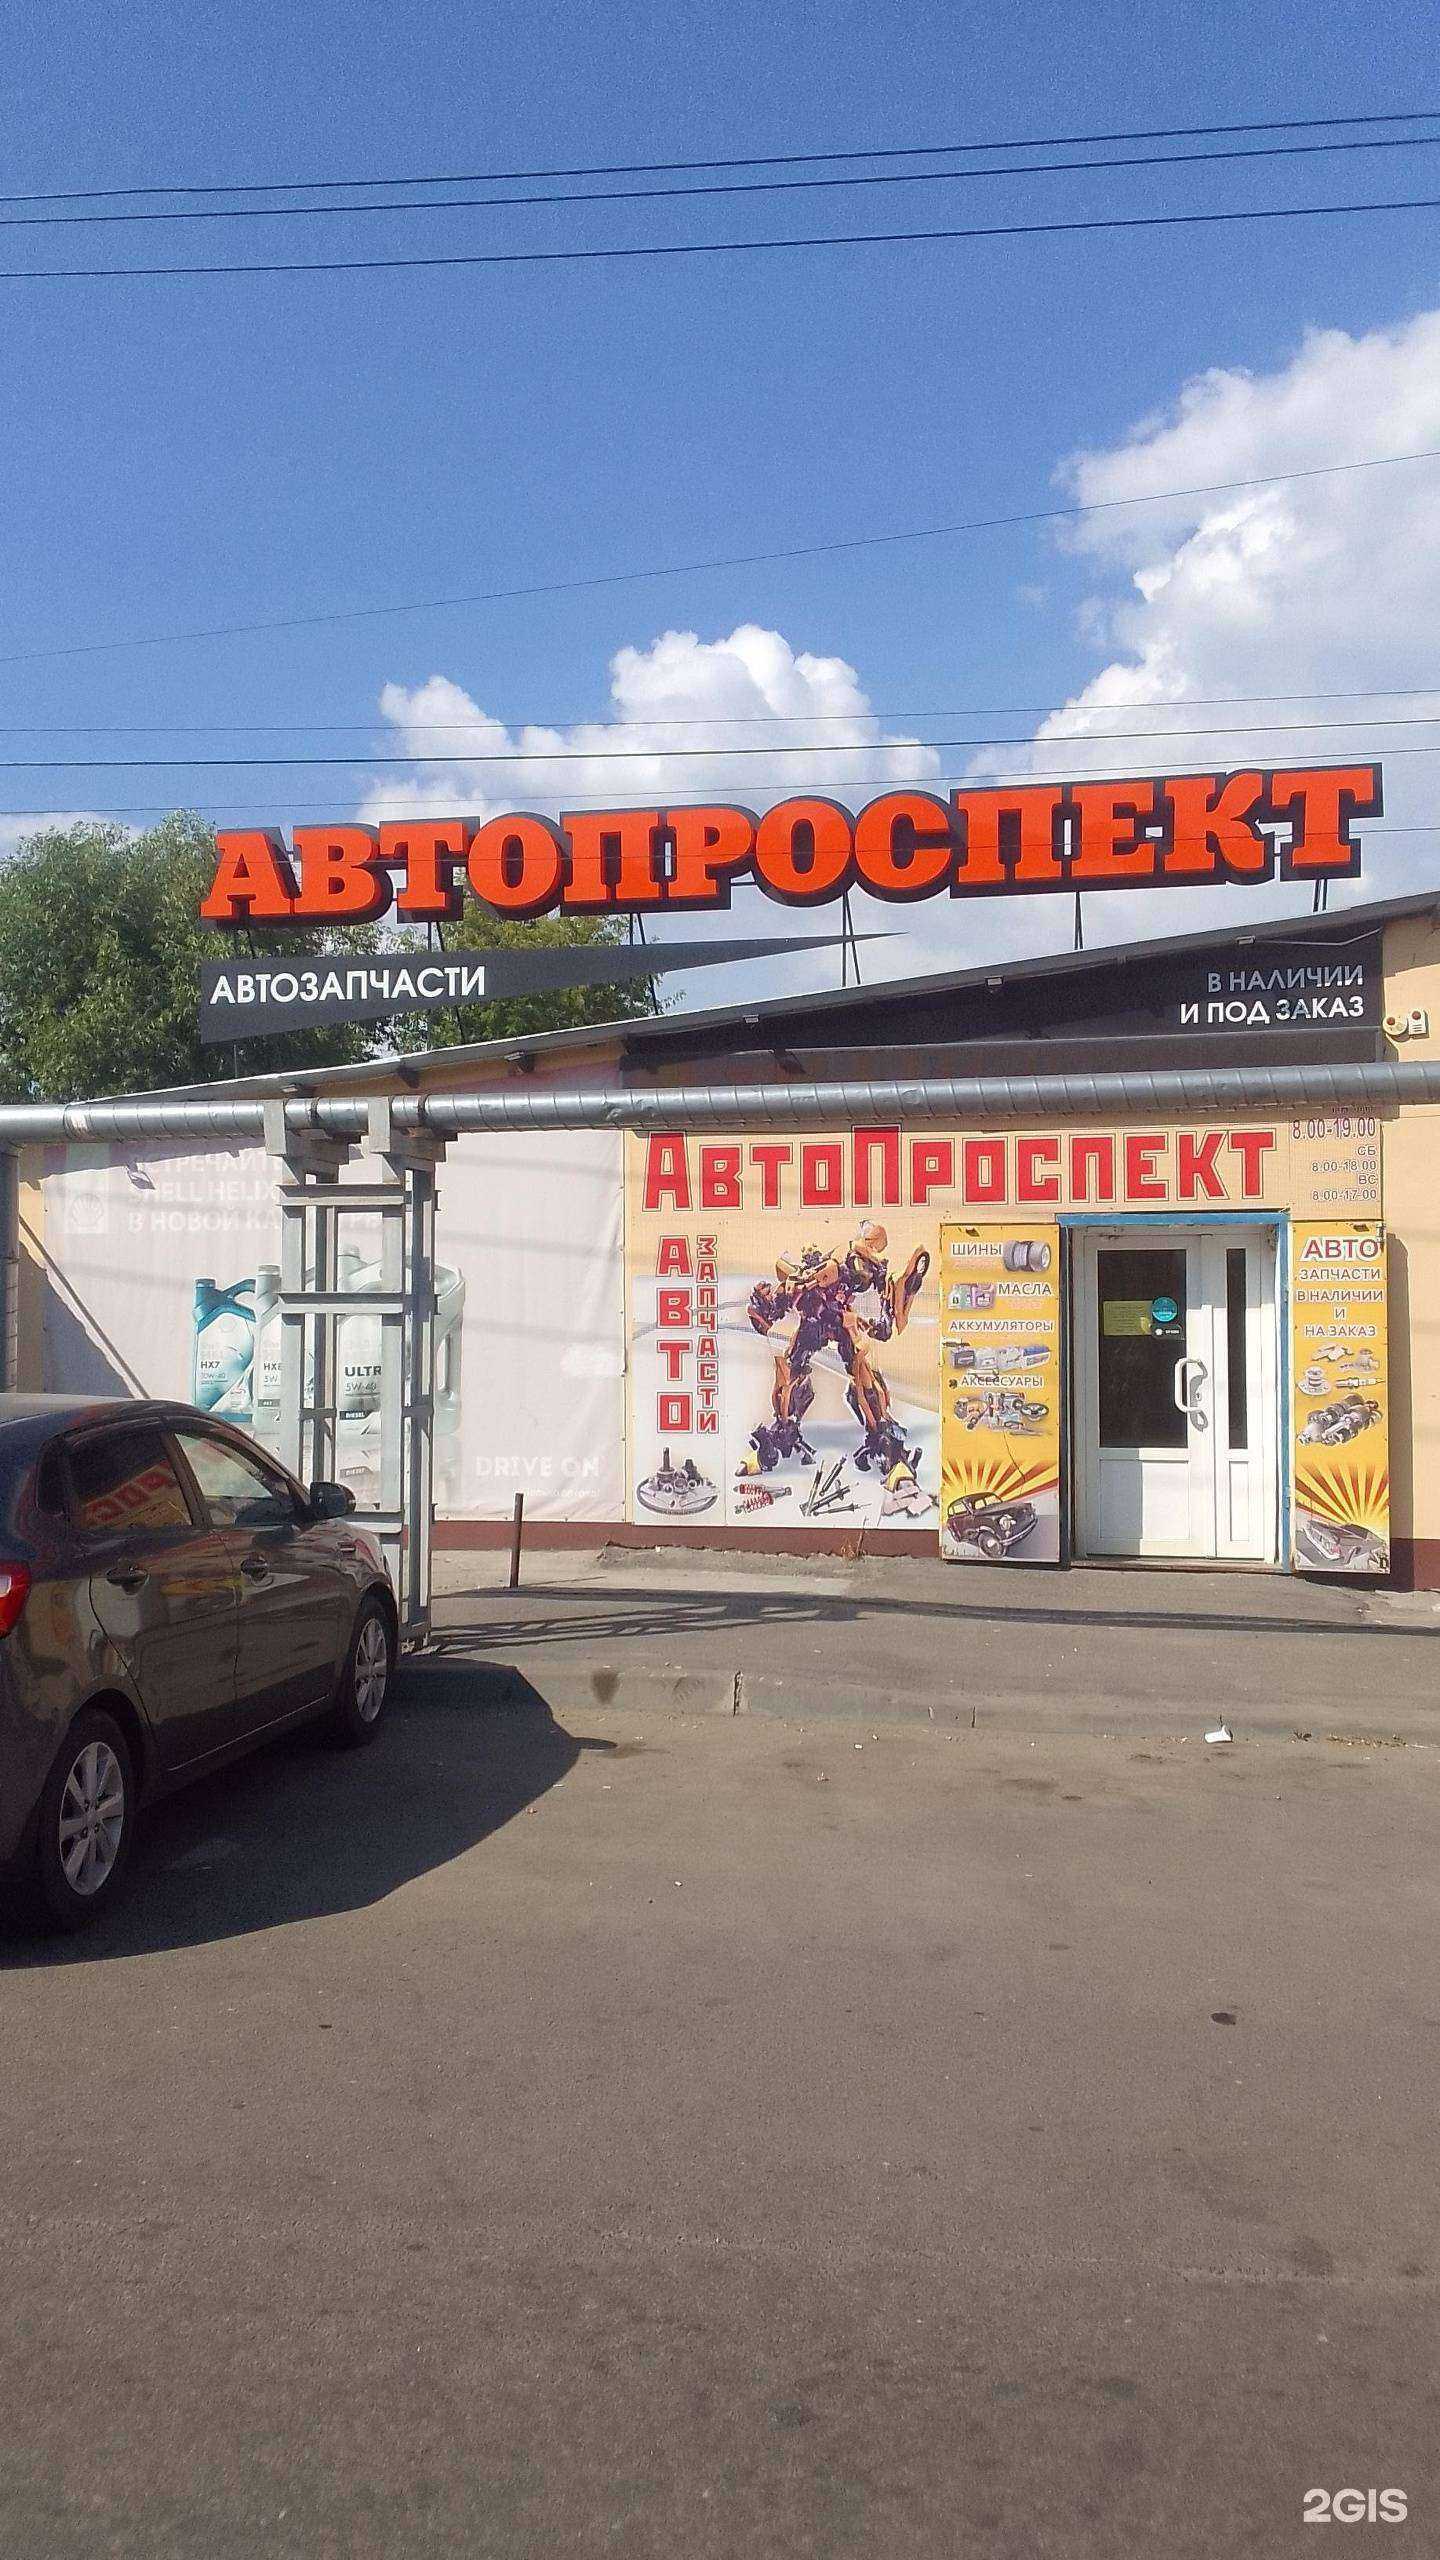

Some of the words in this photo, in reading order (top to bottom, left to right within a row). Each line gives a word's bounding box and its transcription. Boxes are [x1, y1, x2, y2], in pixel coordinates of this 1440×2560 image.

[200, 762, 1383, 926] АВТОПРОСПЕКТ
[209, 965, 486, 1005] АВТОЗАПЧАСТИ
[1208, 972, 1221, 993] В
[1229, 965, 1363, 992] НАЛИЧИИ
[1180, 1003, 1199, 1024] И
[1207, 1001, 1271, 1025] ПОД
[1276, 996, 1364, 1020] ЗАКАЗ
[1357, 1146, 1376, 1156] СБ
[1358, 1174, 1377, 1185] ВС
[151, 1206, 240, 1232] НОВОЙ
[952, 1243, 1002, 1256] ШИНЫ
[1302, 1237, 1380, 1260] АВТО
[1300, 1268, 1381, 1280] ЗАПЧАСТИ
[998, 1283, 1052, 1295] МАСЛА
[1297, 1290, 1306, 1301] В
[1310, 1290, 1383, 1301] НАЛИЧИИ
[1335, 1308, 1345, 1318] И
[950, 1321, 1053, 1331] АККУМУЛЯТОРЫ
[1305, 1326, 1325, 1336] НА
[1329, 1325, 1376, 1336] ЗАКАЗ
[656, 1235, 694, 1434] АВТО
[696, 1235, 720, 1434] ЗАПЧАСТИ
[200, 1360, 221, 1370] HX7
[344, 1366, 382, 1377] ULTR
[961, 1376, 1043, 1387] АКСЕССУАРЫ
[475, 1456, 553, 1477] DRIVE
[561, 1456, 600, 1477] ON
